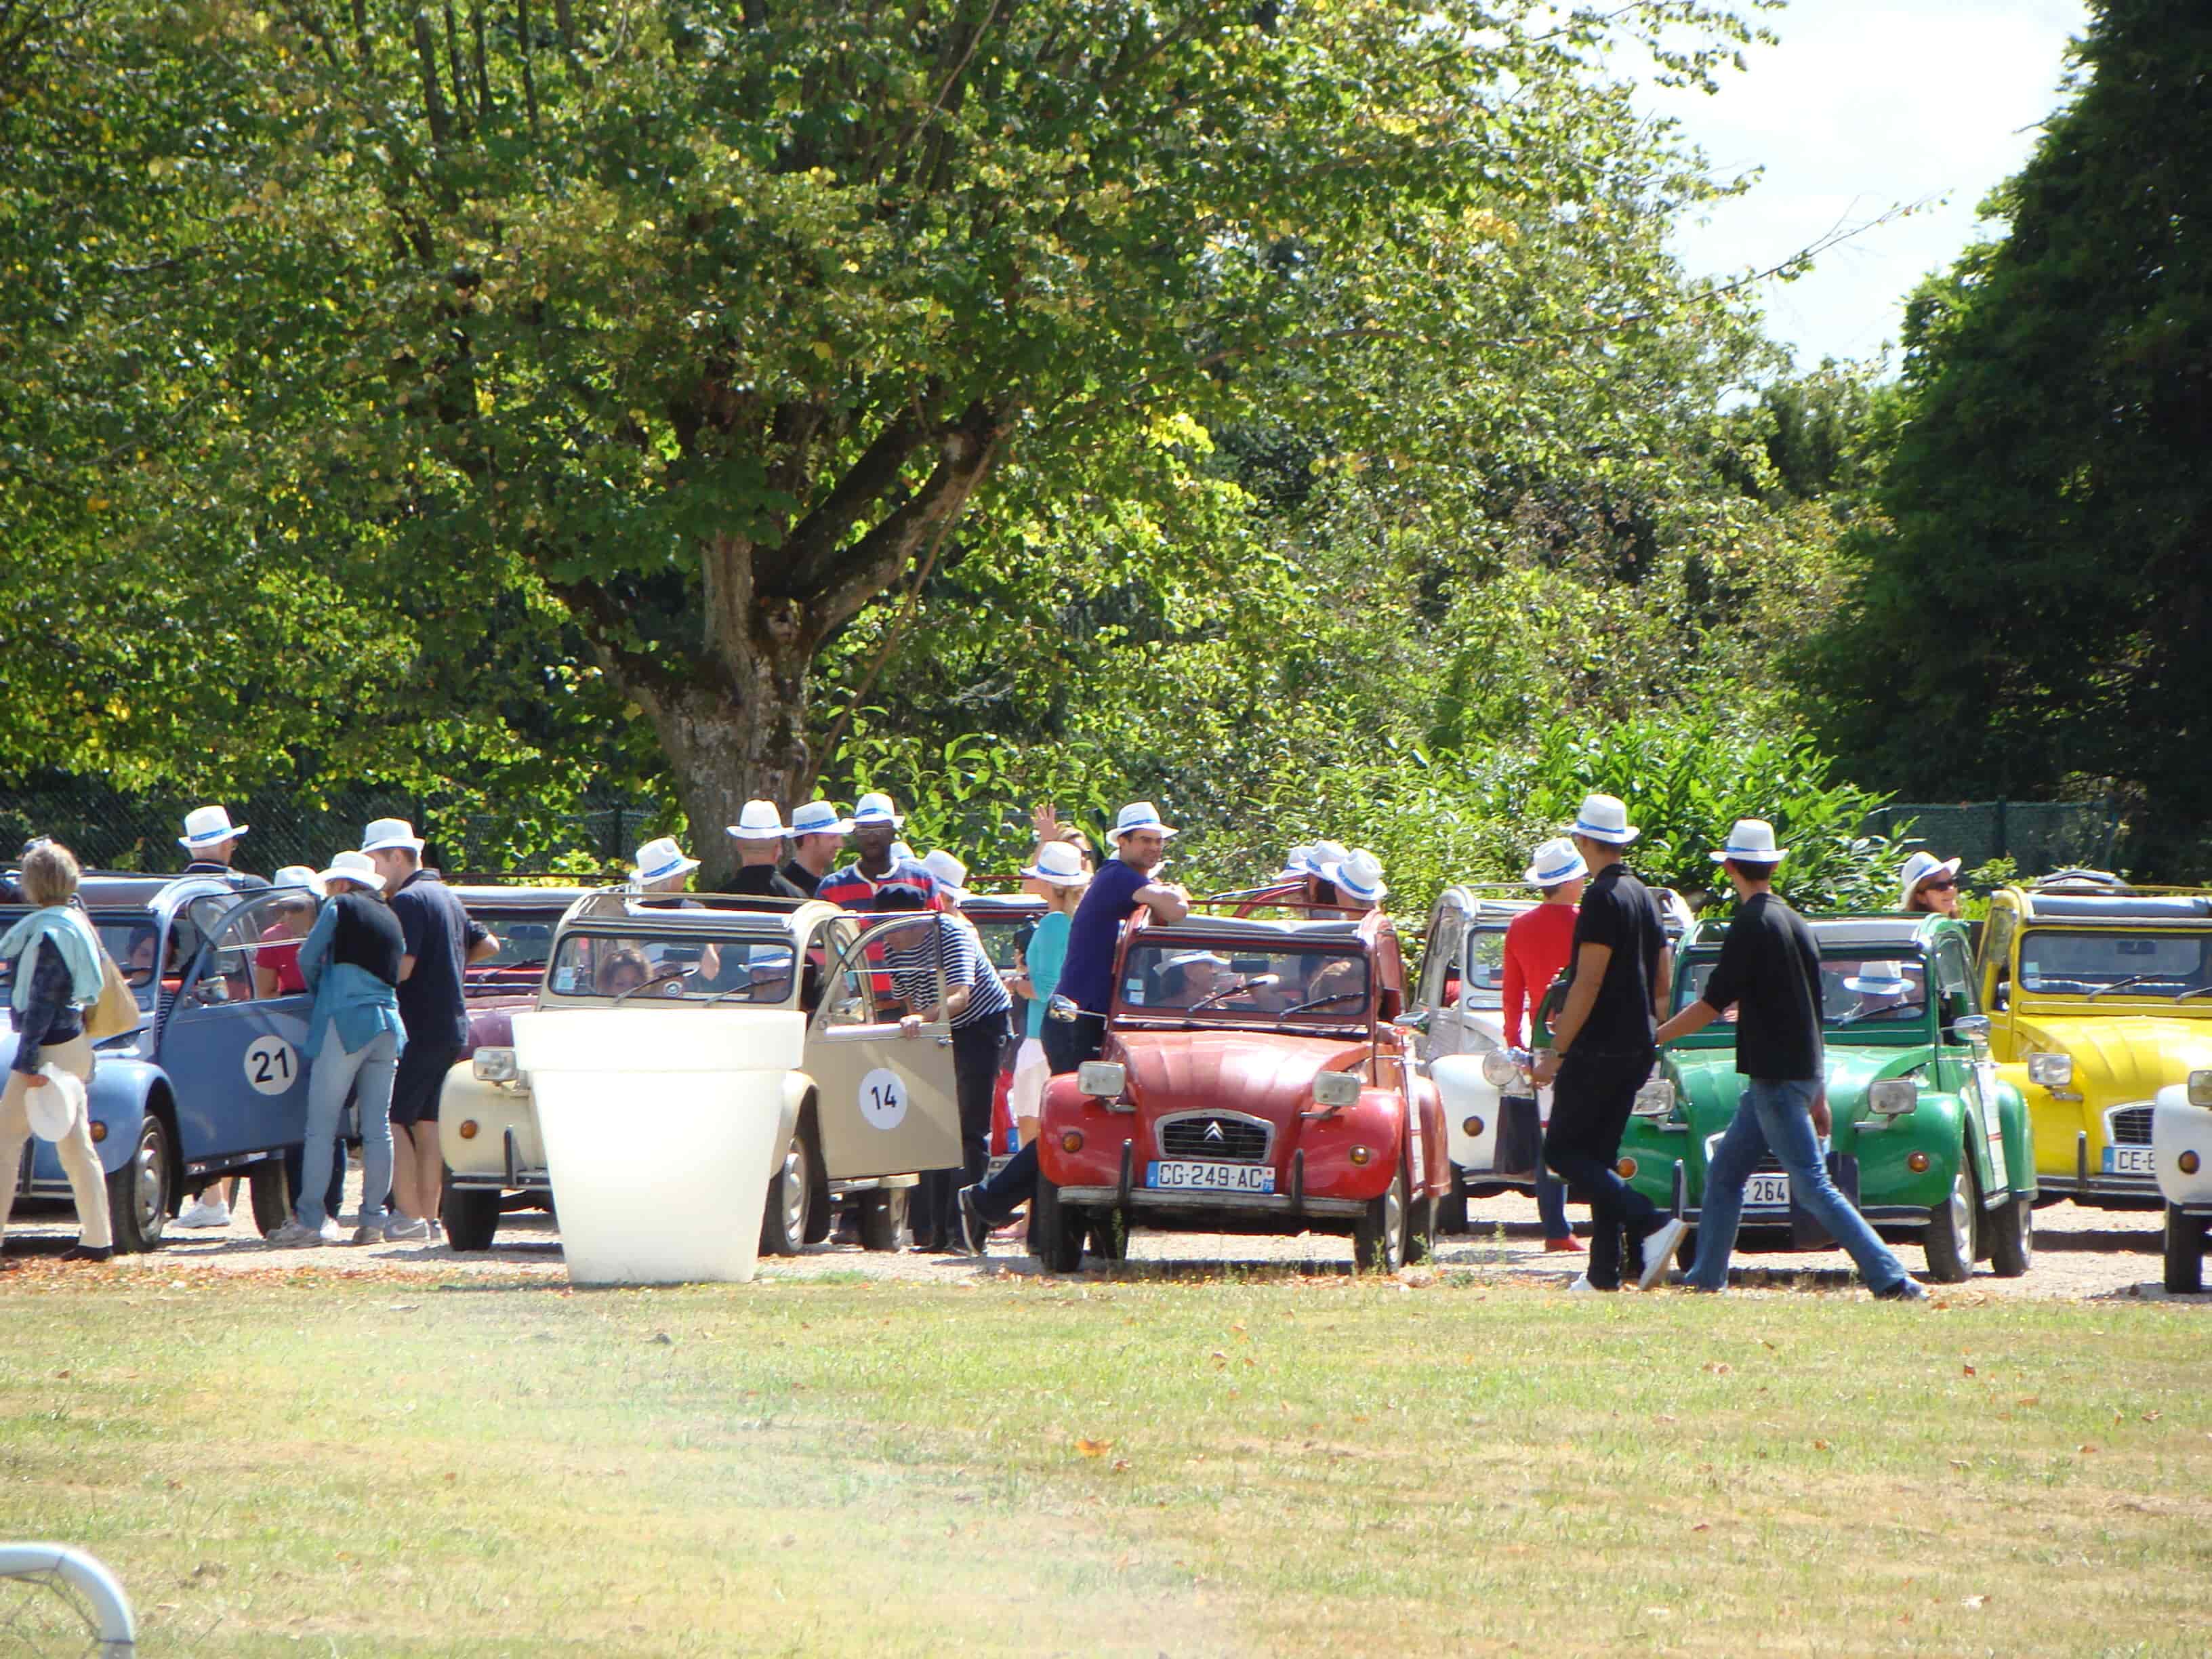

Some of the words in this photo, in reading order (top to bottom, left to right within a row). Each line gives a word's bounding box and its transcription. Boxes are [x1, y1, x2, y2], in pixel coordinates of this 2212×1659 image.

[251, 1047, 289, 1084] 21
[871, 1084, 897, 1110] 14
[1160, 1164, 1263, 1189] CG-249-AC
